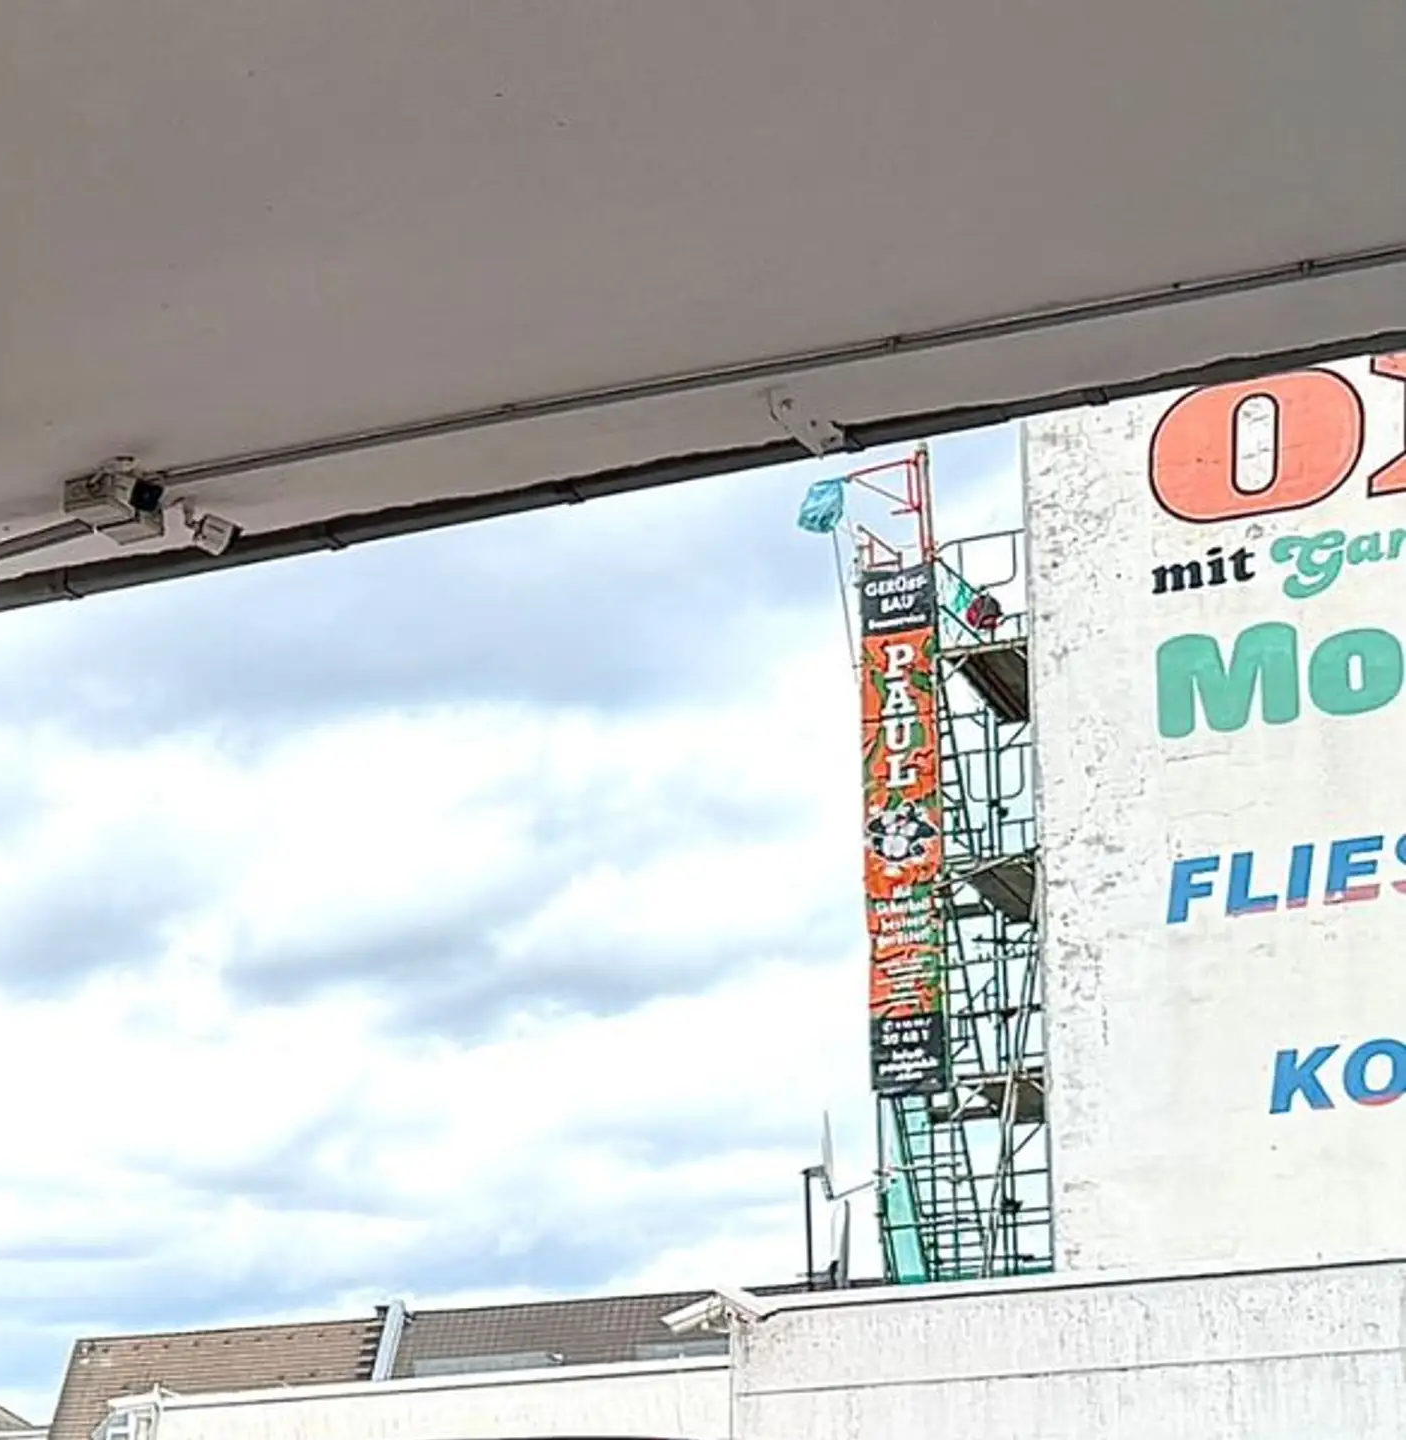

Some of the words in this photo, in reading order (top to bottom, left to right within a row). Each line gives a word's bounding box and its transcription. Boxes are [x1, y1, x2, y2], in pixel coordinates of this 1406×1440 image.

[1151, 547, 1256, 595] mit
[880, 643, 919, 788] PAUL
[1166, 830, 1406, 925] FLIE
